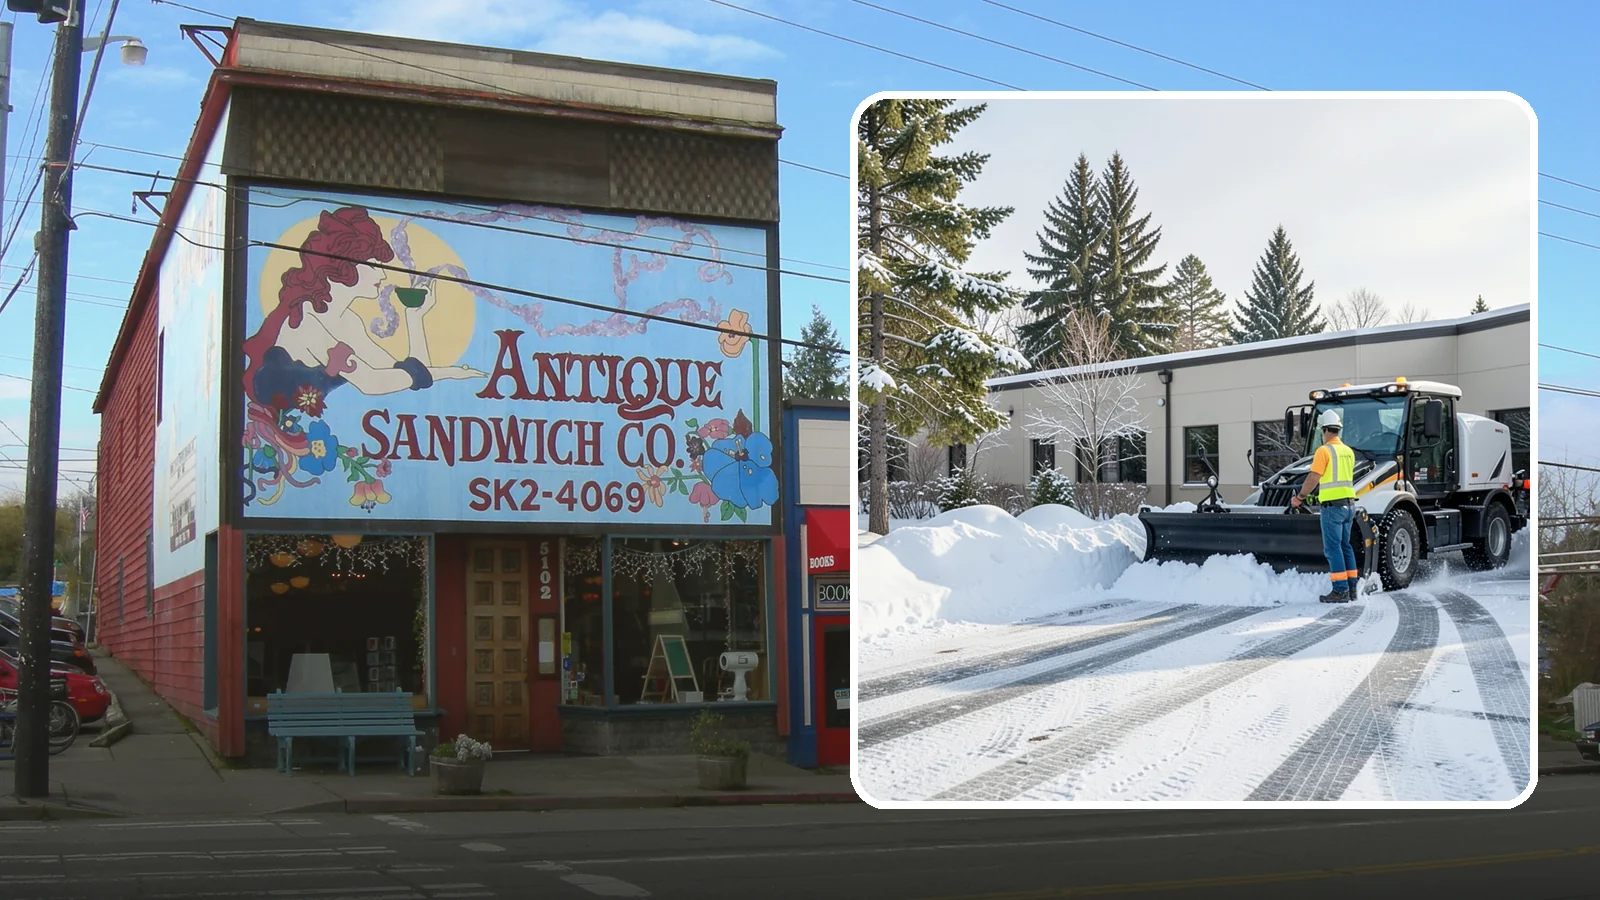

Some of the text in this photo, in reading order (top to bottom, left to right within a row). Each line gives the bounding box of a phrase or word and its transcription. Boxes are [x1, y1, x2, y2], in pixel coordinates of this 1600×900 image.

[475, 329, 723, 420] ANTIQUE
[361, 408, 685, 469] SANDWICH CO.
[468, 478, 646, 513] SK2-4069
[540, 542, 551, 599] 5102
[809, 555, 835, 569] BOOKS
